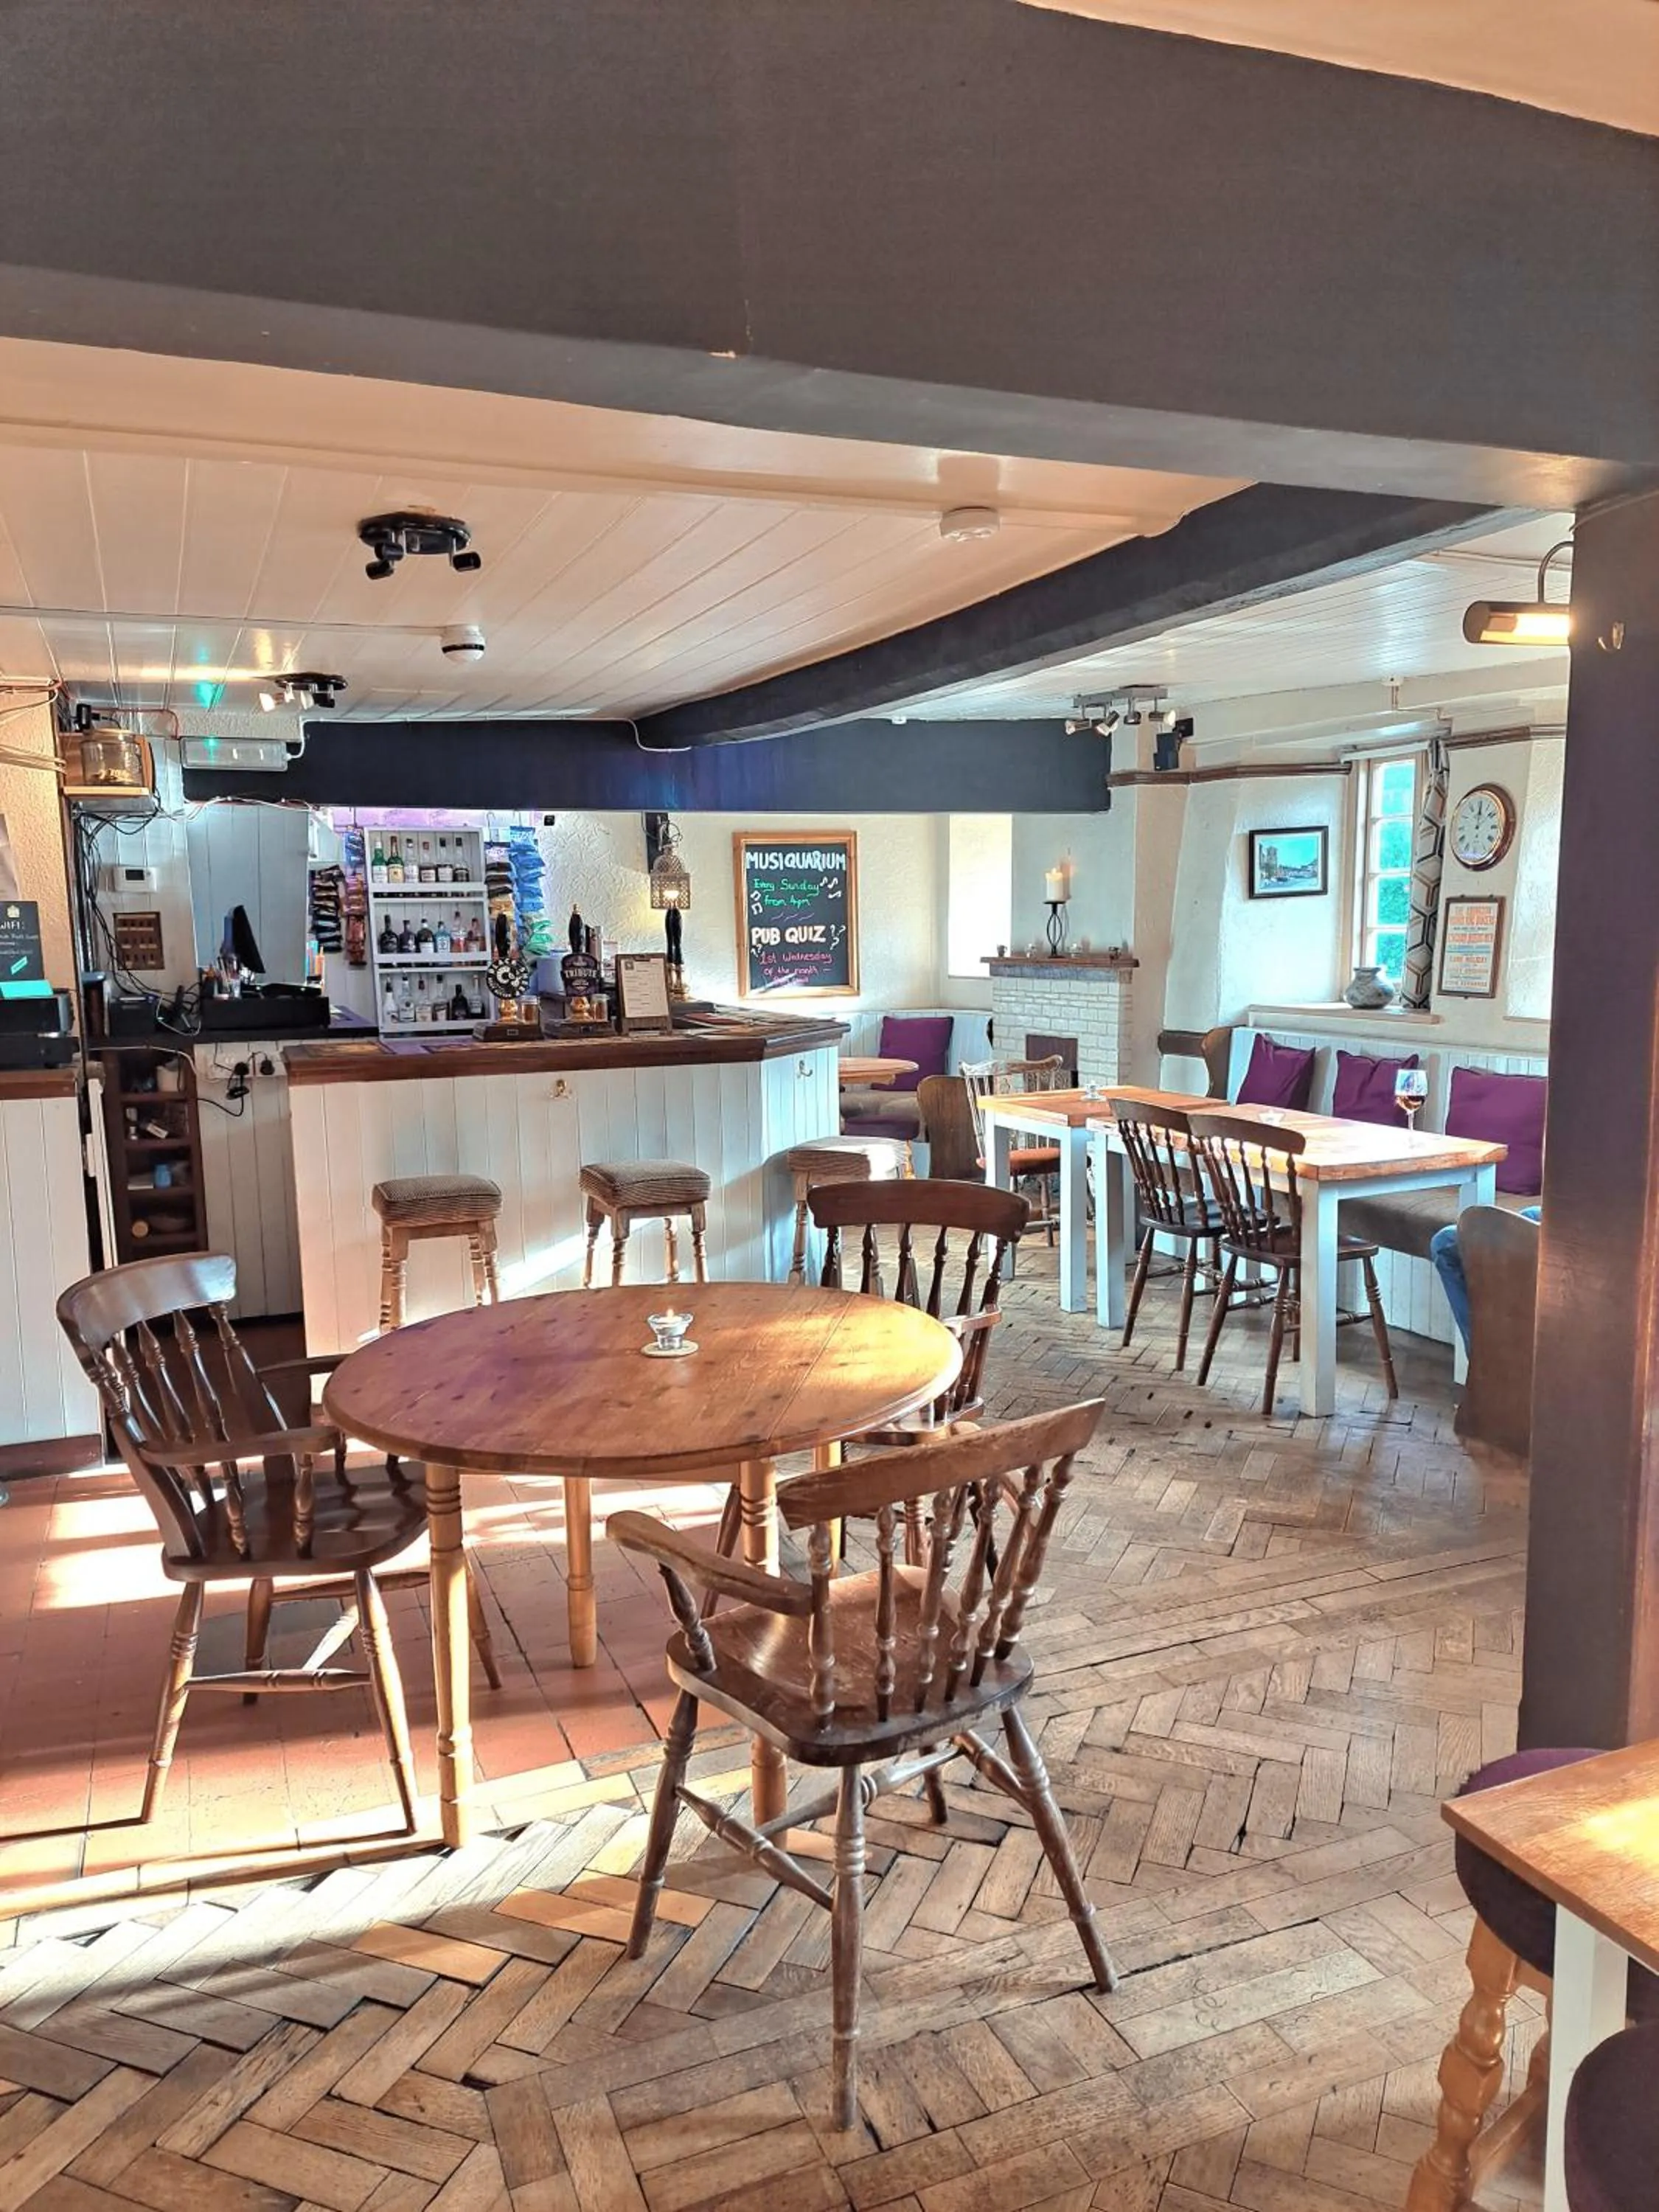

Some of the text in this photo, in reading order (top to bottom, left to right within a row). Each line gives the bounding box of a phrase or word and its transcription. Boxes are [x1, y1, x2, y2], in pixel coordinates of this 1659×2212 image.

[746, 851, 846, 872] MUSIQUARIUM
[780, 878, 820, 897] Sunday
[751, 927, 780, 946] PUB
[785, 925, 826, 944] QUIZ
